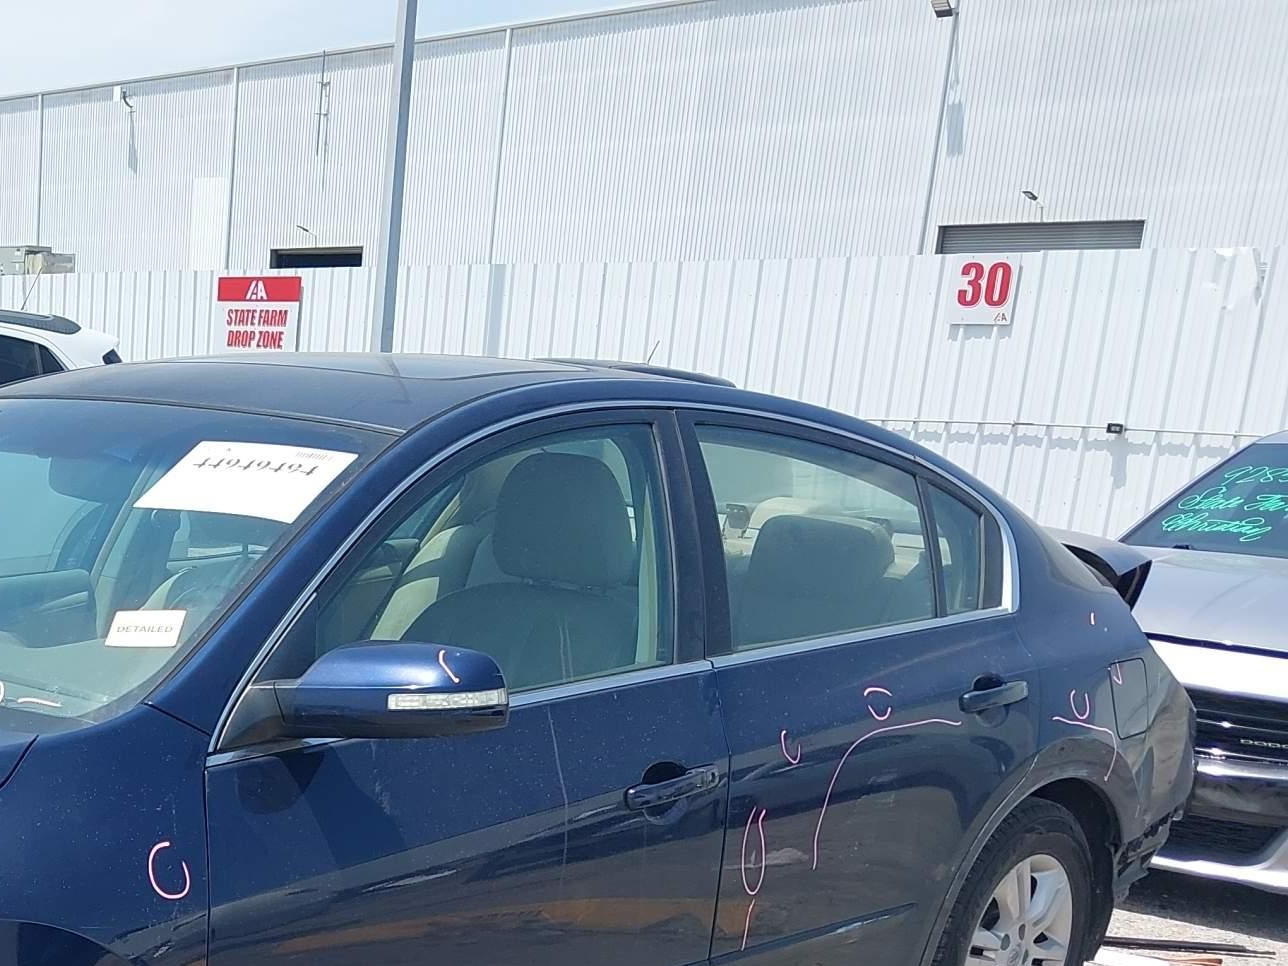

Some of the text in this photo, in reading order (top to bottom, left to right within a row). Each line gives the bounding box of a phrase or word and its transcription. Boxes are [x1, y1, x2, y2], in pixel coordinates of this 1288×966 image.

[957, 262, 1012, 307] 30
[226, 309, 289, 328] STATE FARM
[226, 330, 285, 350] DROP ZONE
[116, 625, 174, 633] DETAILED
